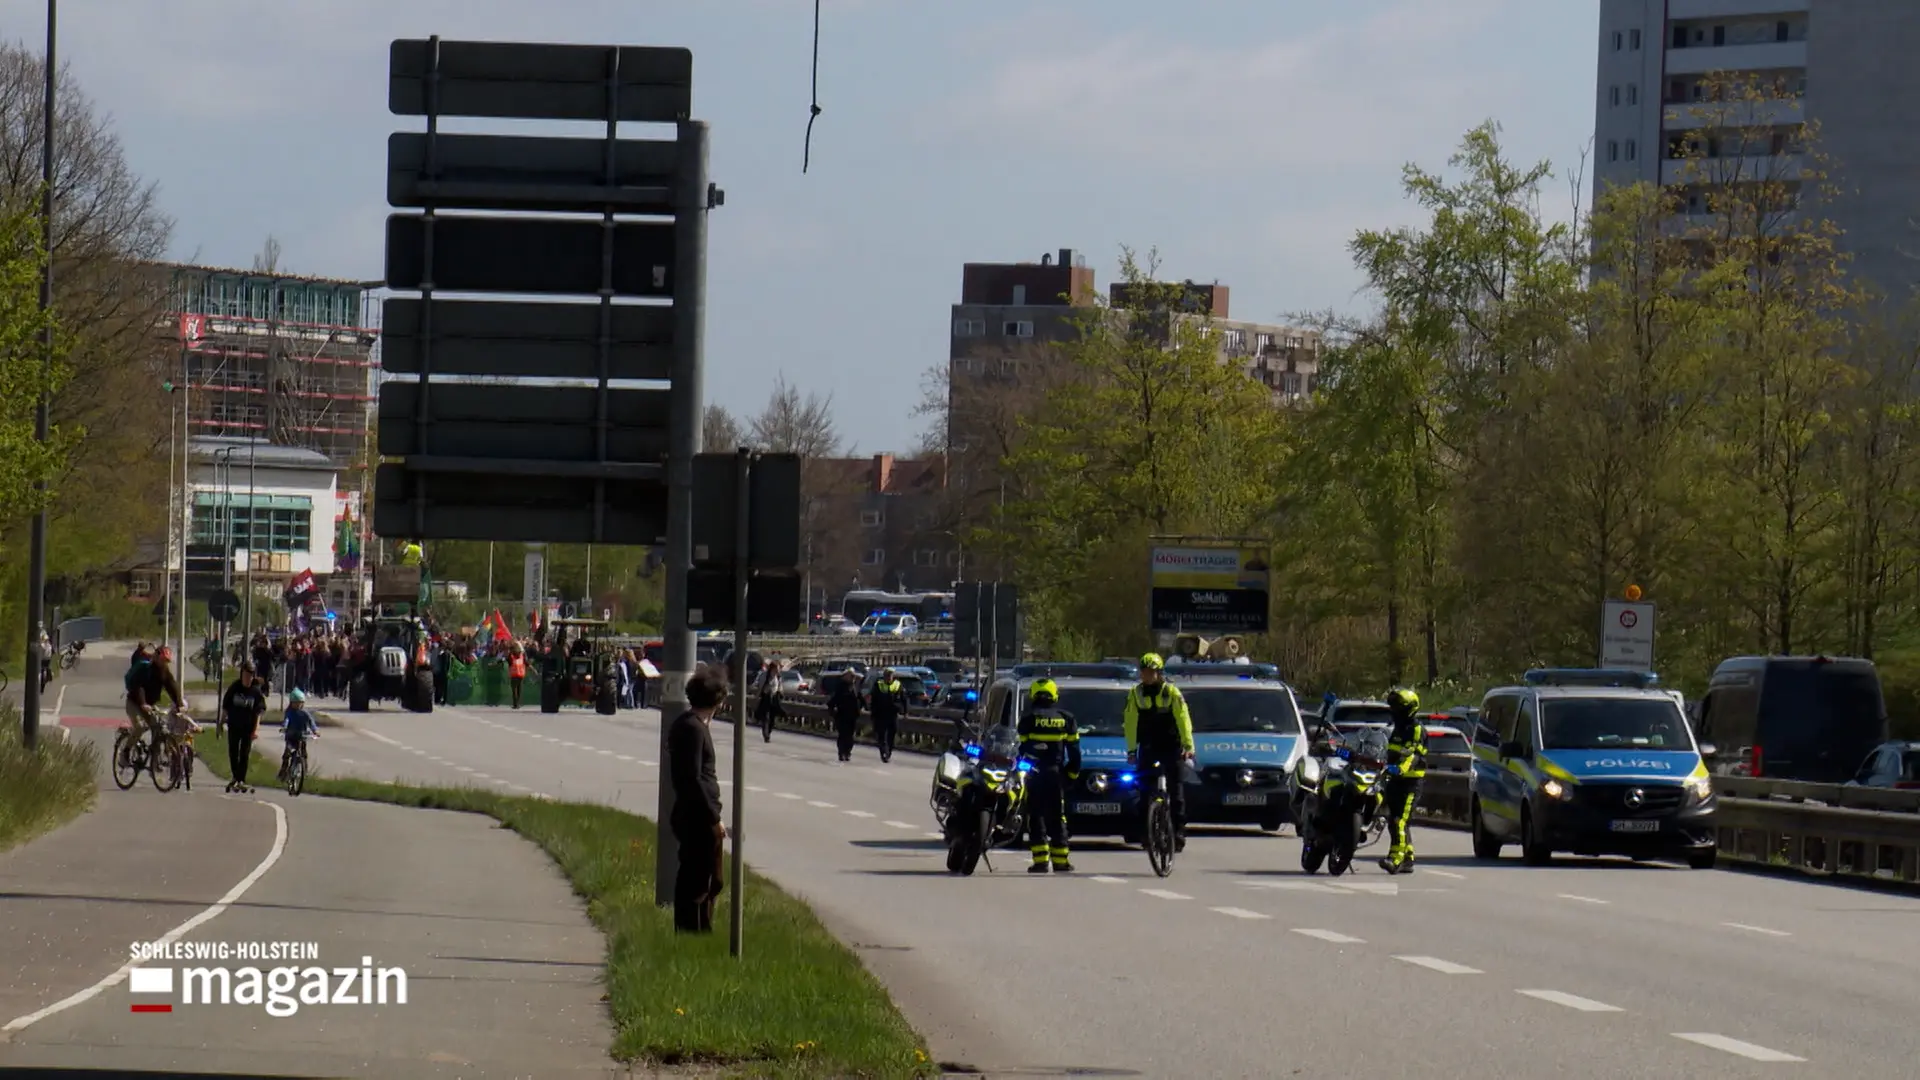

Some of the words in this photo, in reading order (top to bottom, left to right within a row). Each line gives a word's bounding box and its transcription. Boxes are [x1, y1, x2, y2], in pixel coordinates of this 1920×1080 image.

[1035, 718, 1066, 728] POLIZEI
[1203, 741, 1278, 753] POLIZEI
[1584, 758, 1672, 770] POLIZEI
